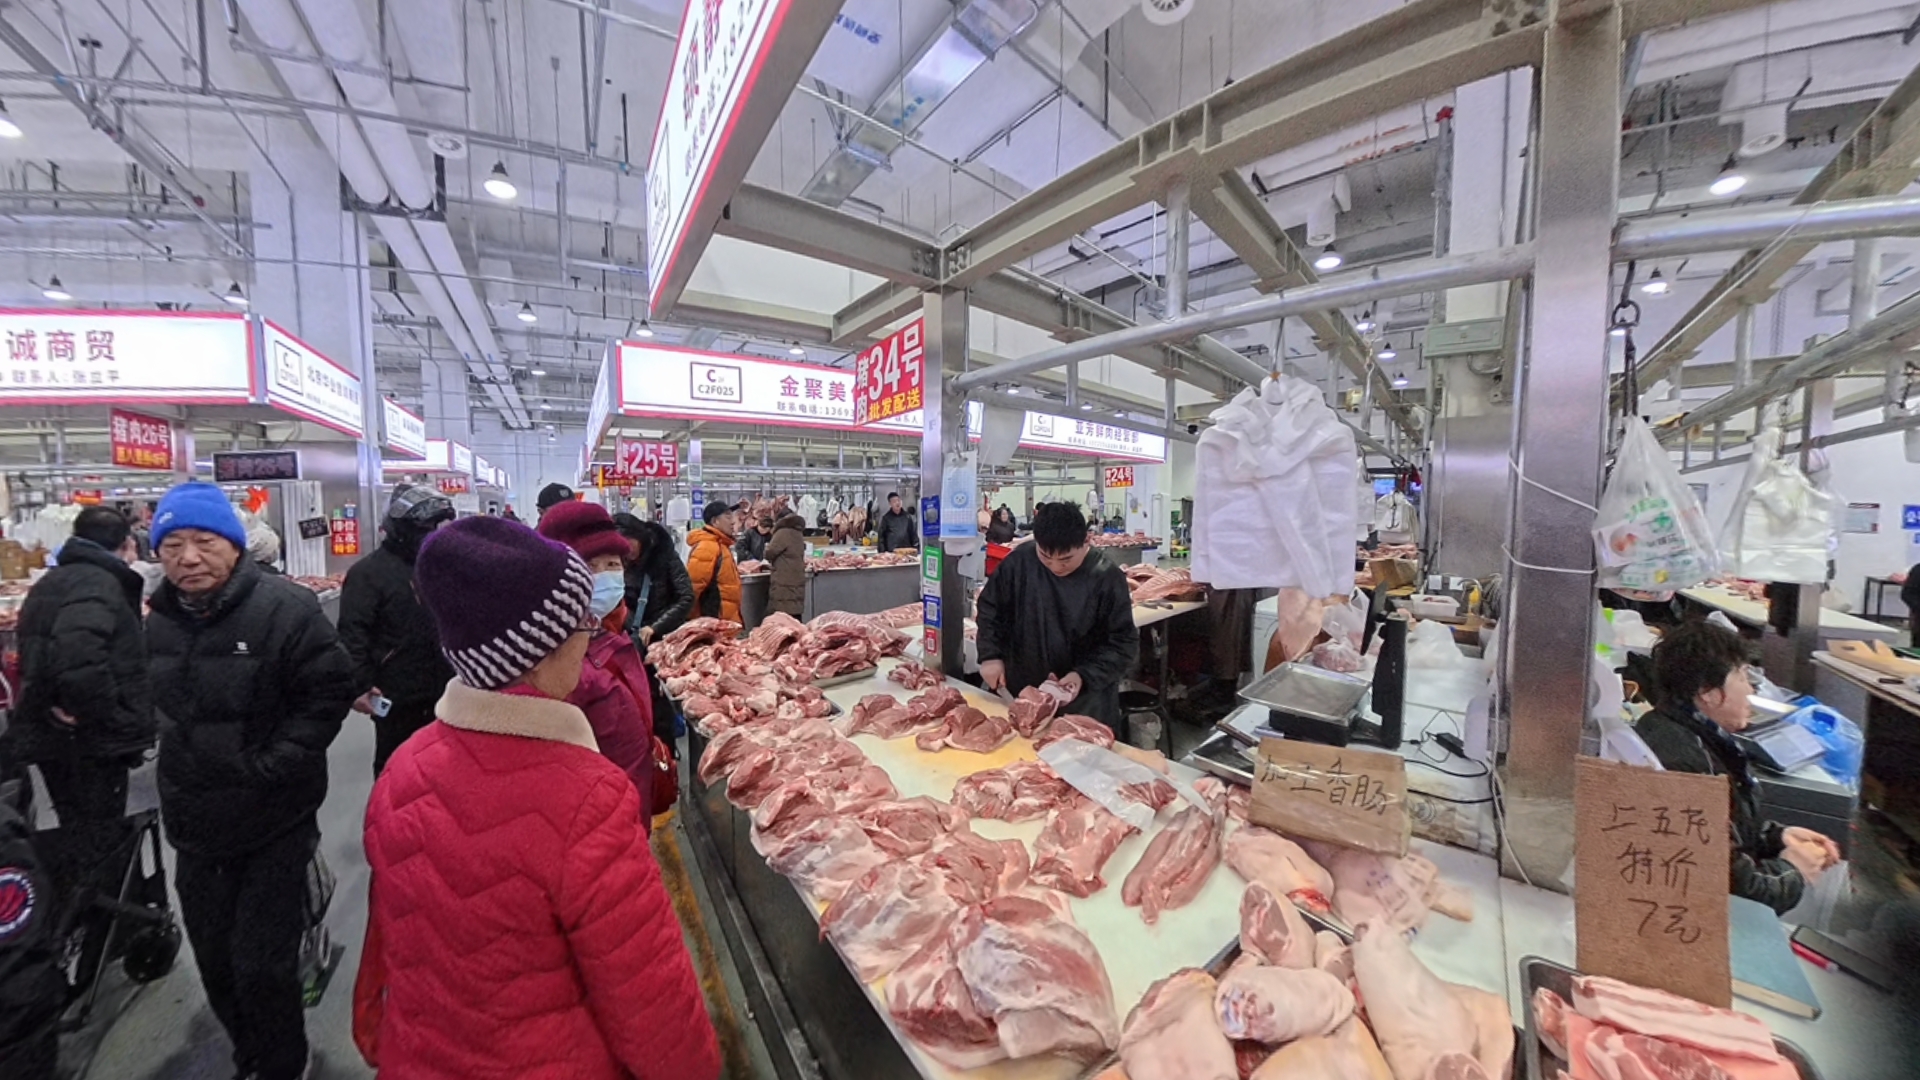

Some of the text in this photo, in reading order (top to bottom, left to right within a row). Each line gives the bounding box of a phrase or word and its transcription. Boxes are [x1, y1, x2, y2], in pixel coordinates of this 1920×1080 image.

[5, 329, 115, 361] 诚商贸
[869, 324, 923, 401] 34号
[697, 384, 735, 396] C2F025
[869, 387, 920, 421] 批发配送
[1260, 754, 1388, 816] 加工香肠
[1616, 841, 1697, 898] 特价
[1627, 897, 1701, 944] 7元
